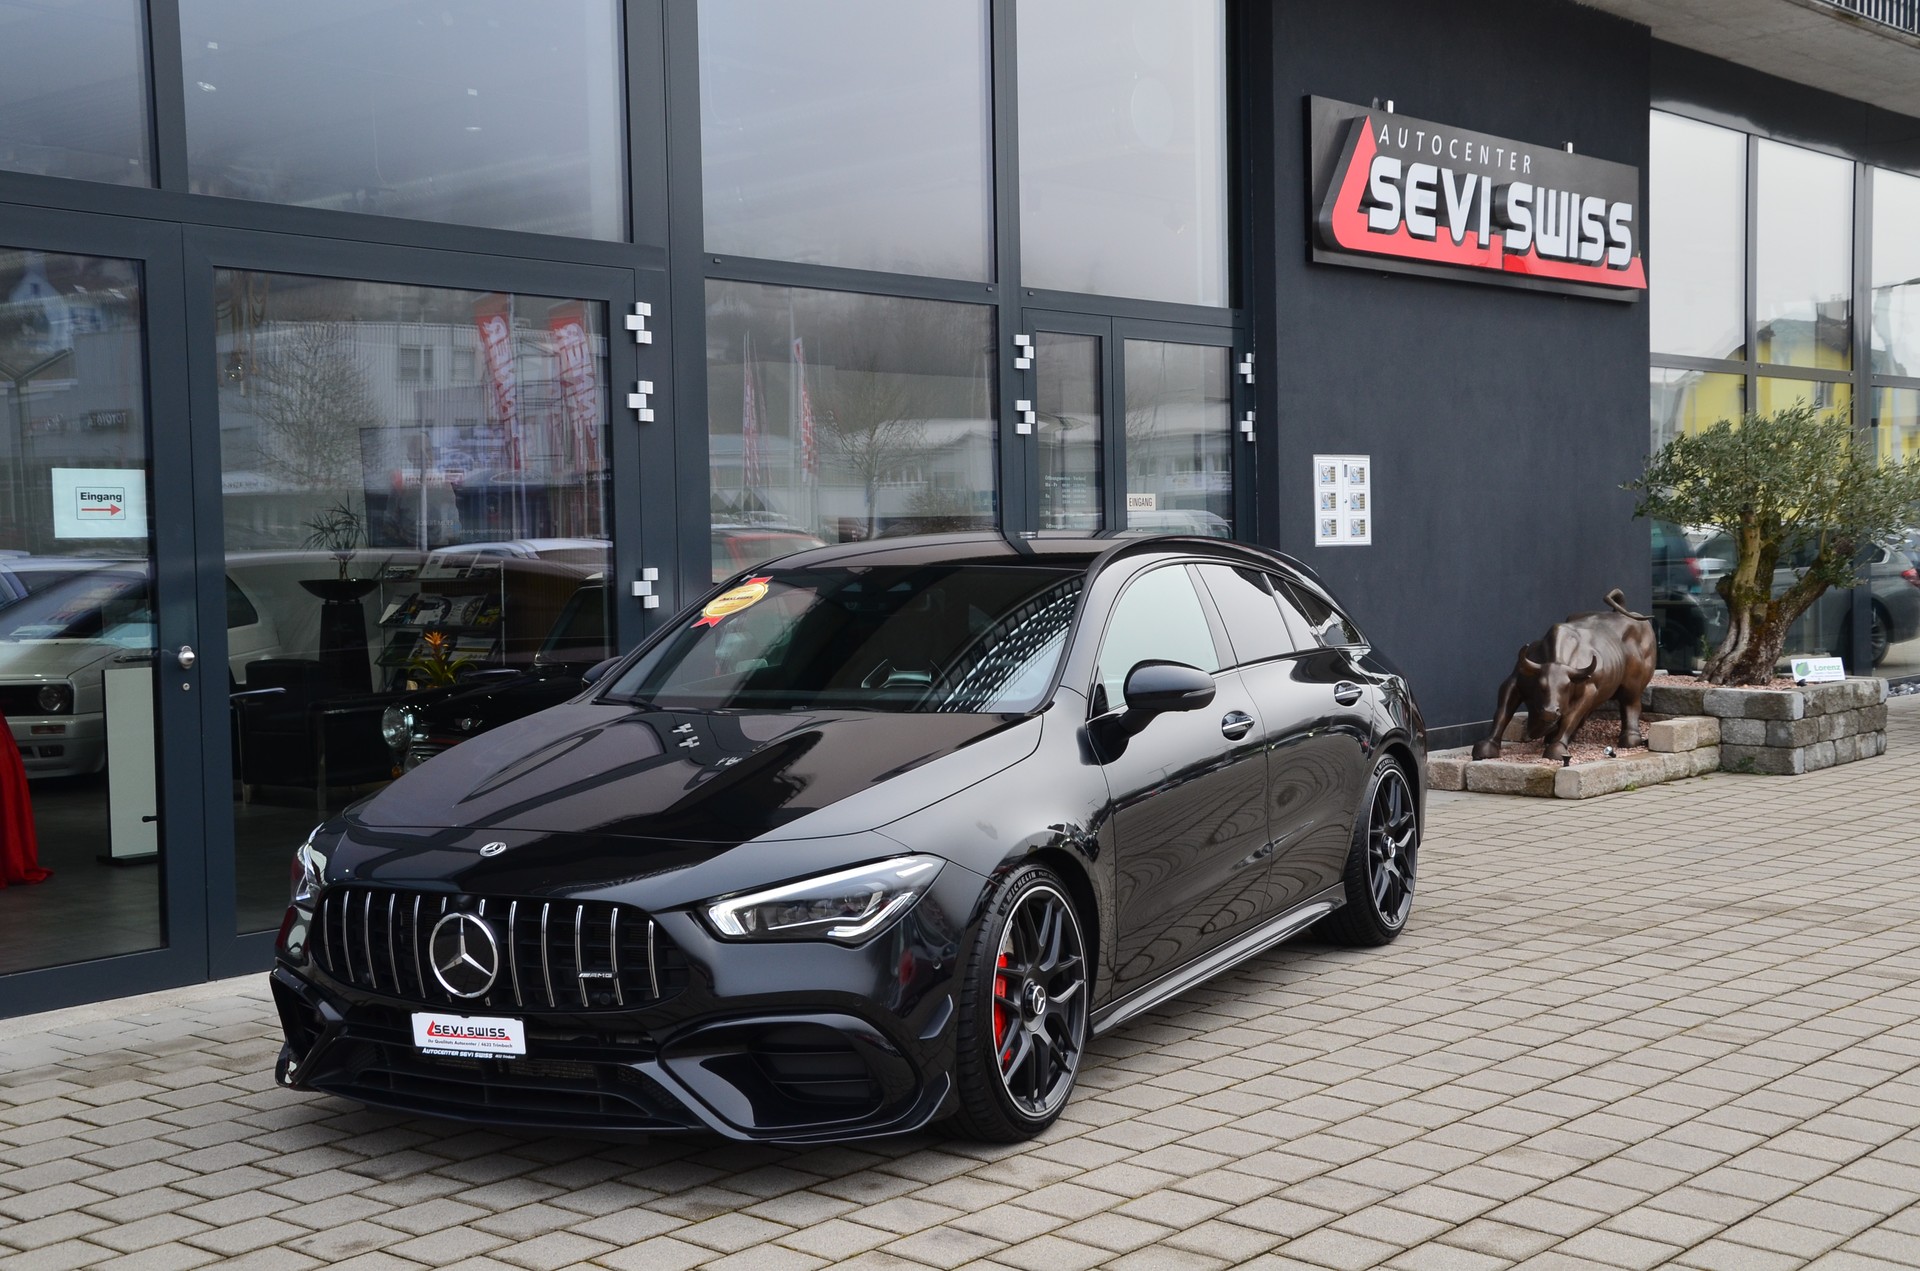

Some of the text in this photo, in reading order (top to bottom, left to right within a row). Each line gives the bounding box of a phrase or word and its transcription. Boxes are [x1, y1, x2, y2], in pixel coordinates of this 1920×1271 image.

[1378, 123, 1531, 174] AUTOCENTER
[1368, 155, 1632, 266] SEVI SWISS
[80, 492, 122, 503] Eingang
[1129, 497, 1153, 507] EINGANG
[1006, 871, 1037, 903] MICHELIN
[434, 1024, 506, 1038] SEVI SWISS
